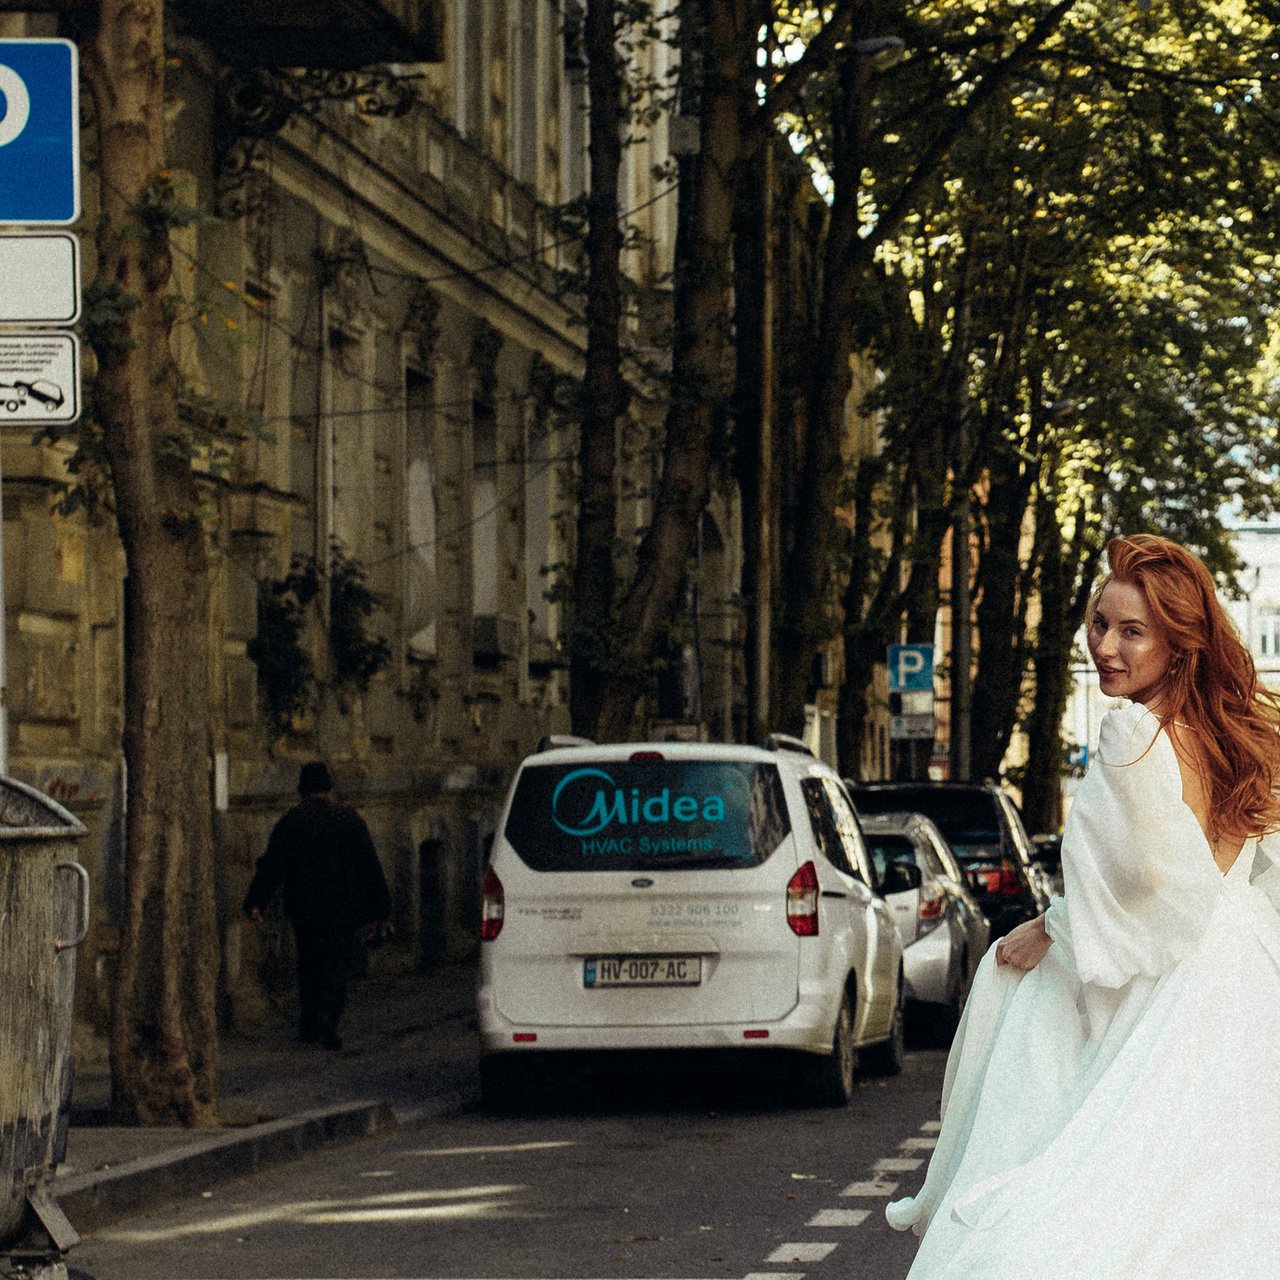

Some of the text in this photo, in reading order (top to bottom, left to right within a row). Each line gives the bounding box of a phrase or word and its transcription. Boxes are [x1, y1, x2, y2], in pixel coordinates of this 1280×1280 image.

[898, 651, 924, 687] P
[574, 786, 726, 829] Midea
[582, 836, 713, 856] HVAC Systems
[715, 903, 739, 915] 100
[601, 960, 687, 980] HV-007-AC
